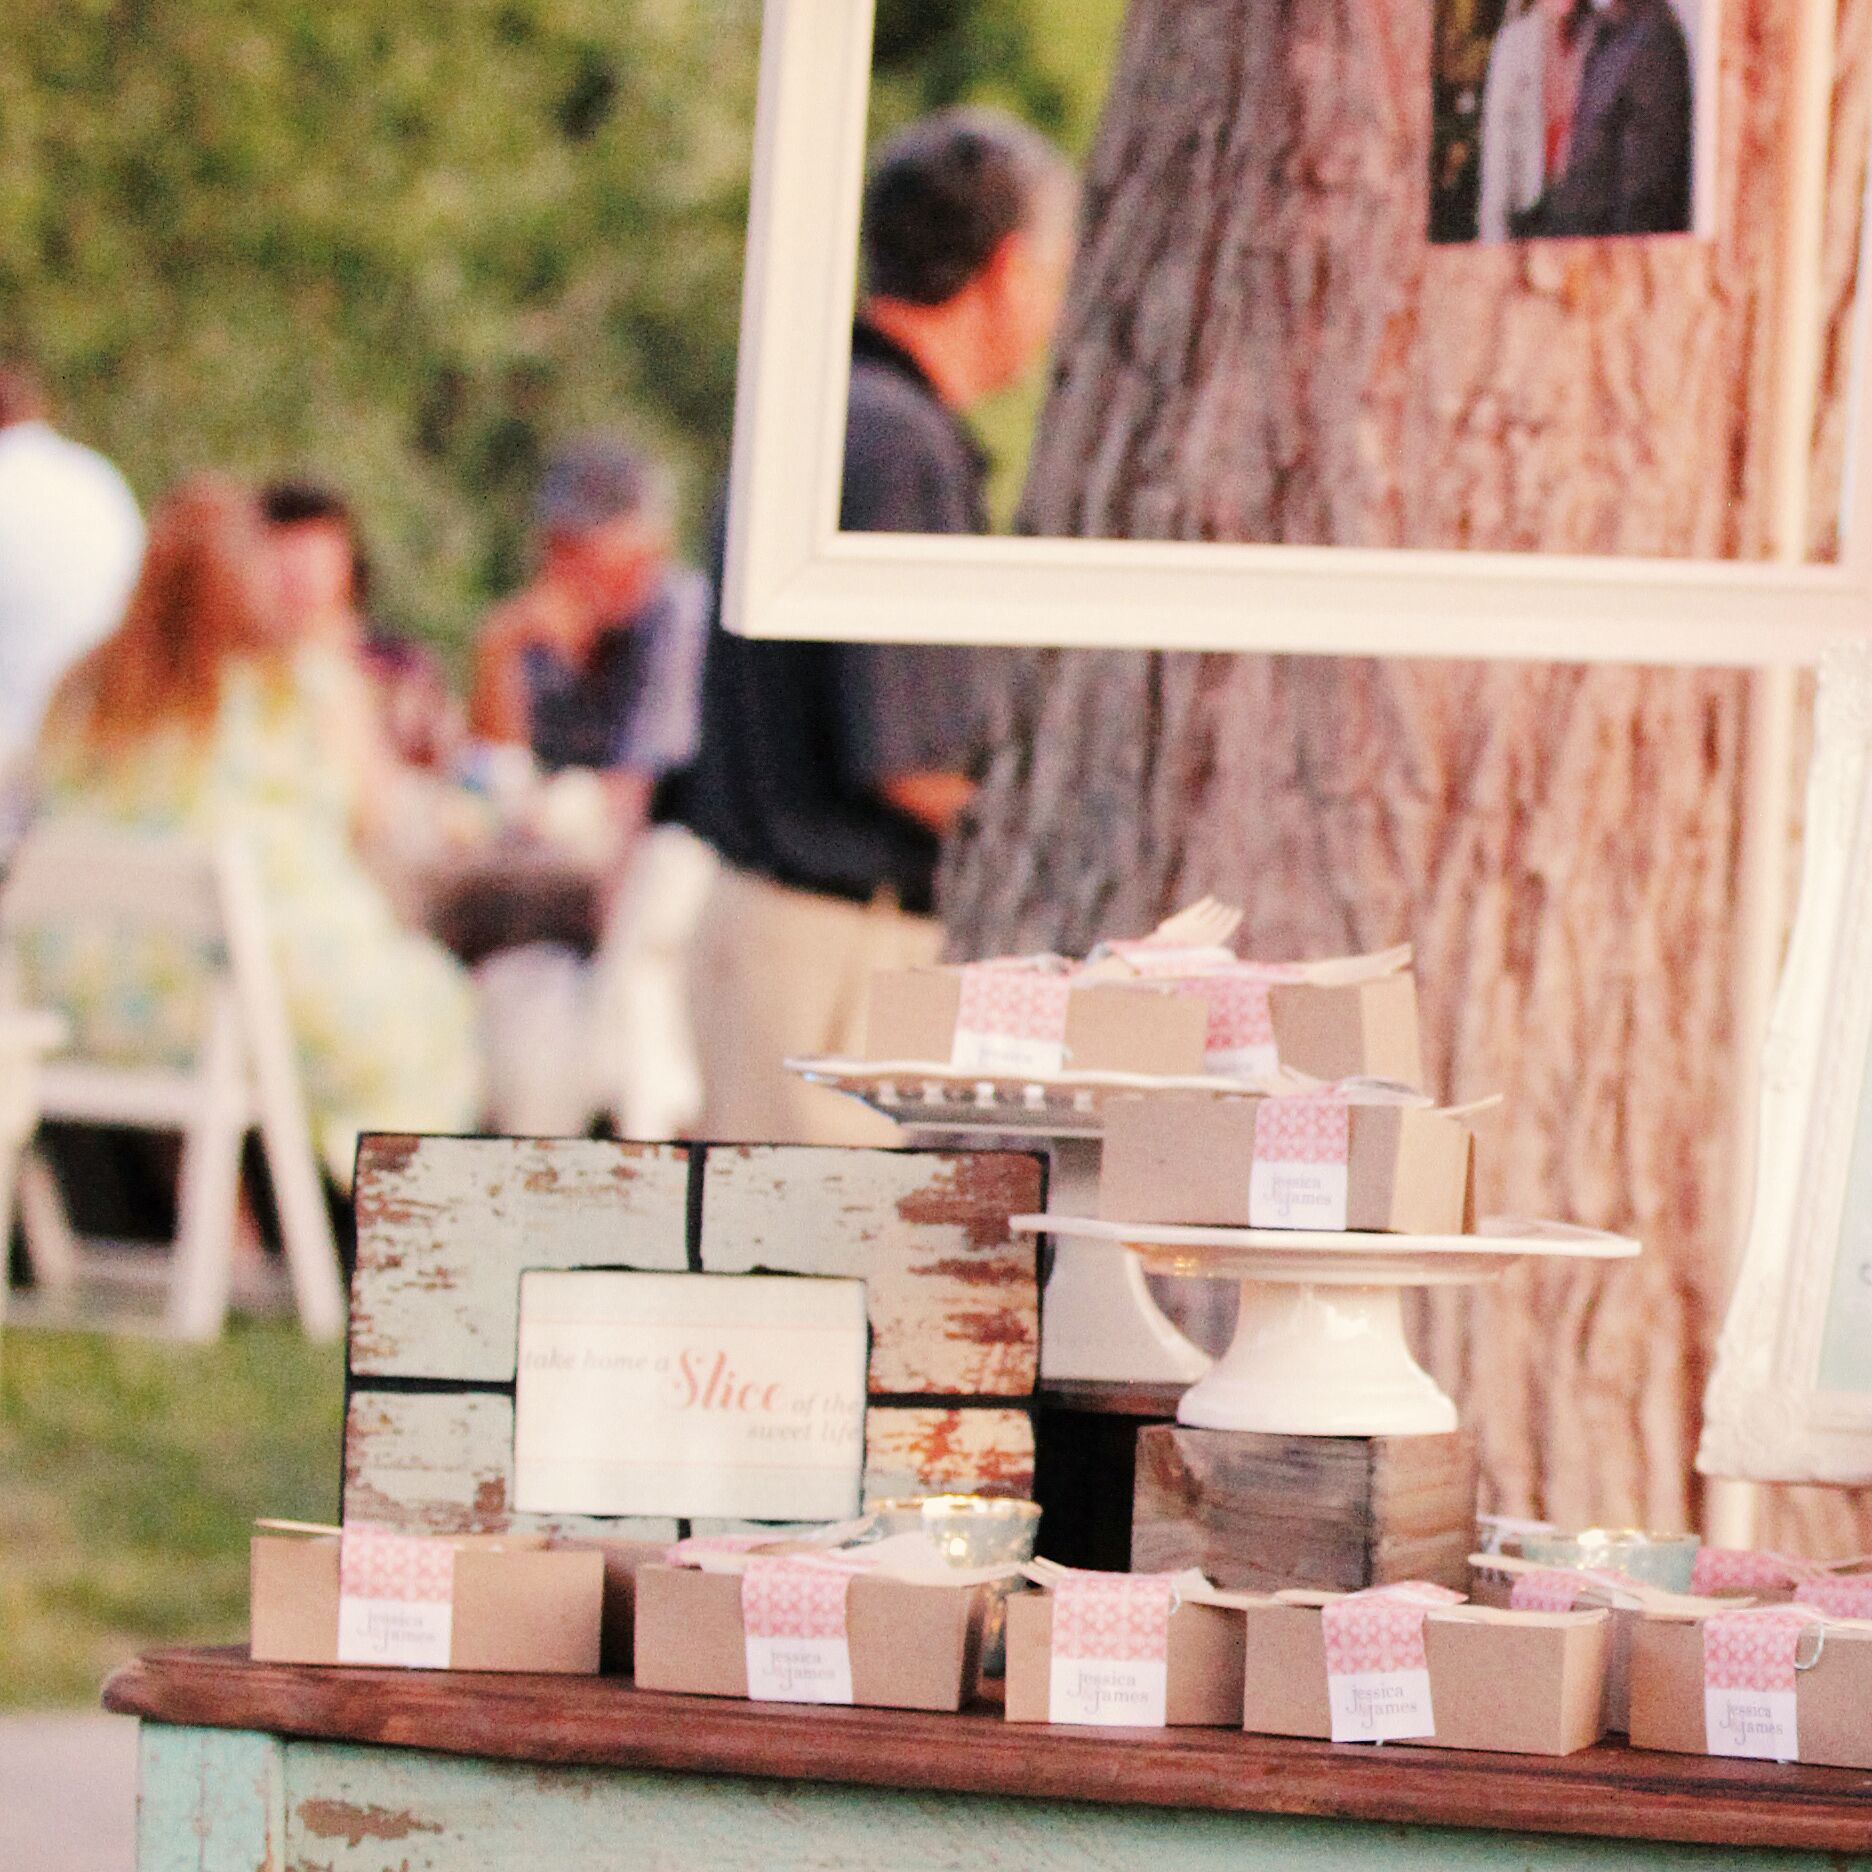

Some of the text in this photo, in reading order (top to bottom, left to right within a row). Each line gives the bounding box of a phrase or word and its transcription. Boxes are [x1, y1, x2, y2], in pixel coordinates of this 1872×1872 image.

[584, 1349, 647, 1372] home
[672, 1346, 783, 1413] Slice
[1066, 1667, 1137, 1698] jessica
[1345, 1681, 1405, 1714] jessica
[1083, 1684, 1150, 1715] james
[1361, 1697, 1418, 1730] james
[1718, 1699, 1772, 1729] jessica
[1733, 1715, 1784, 1746] james
